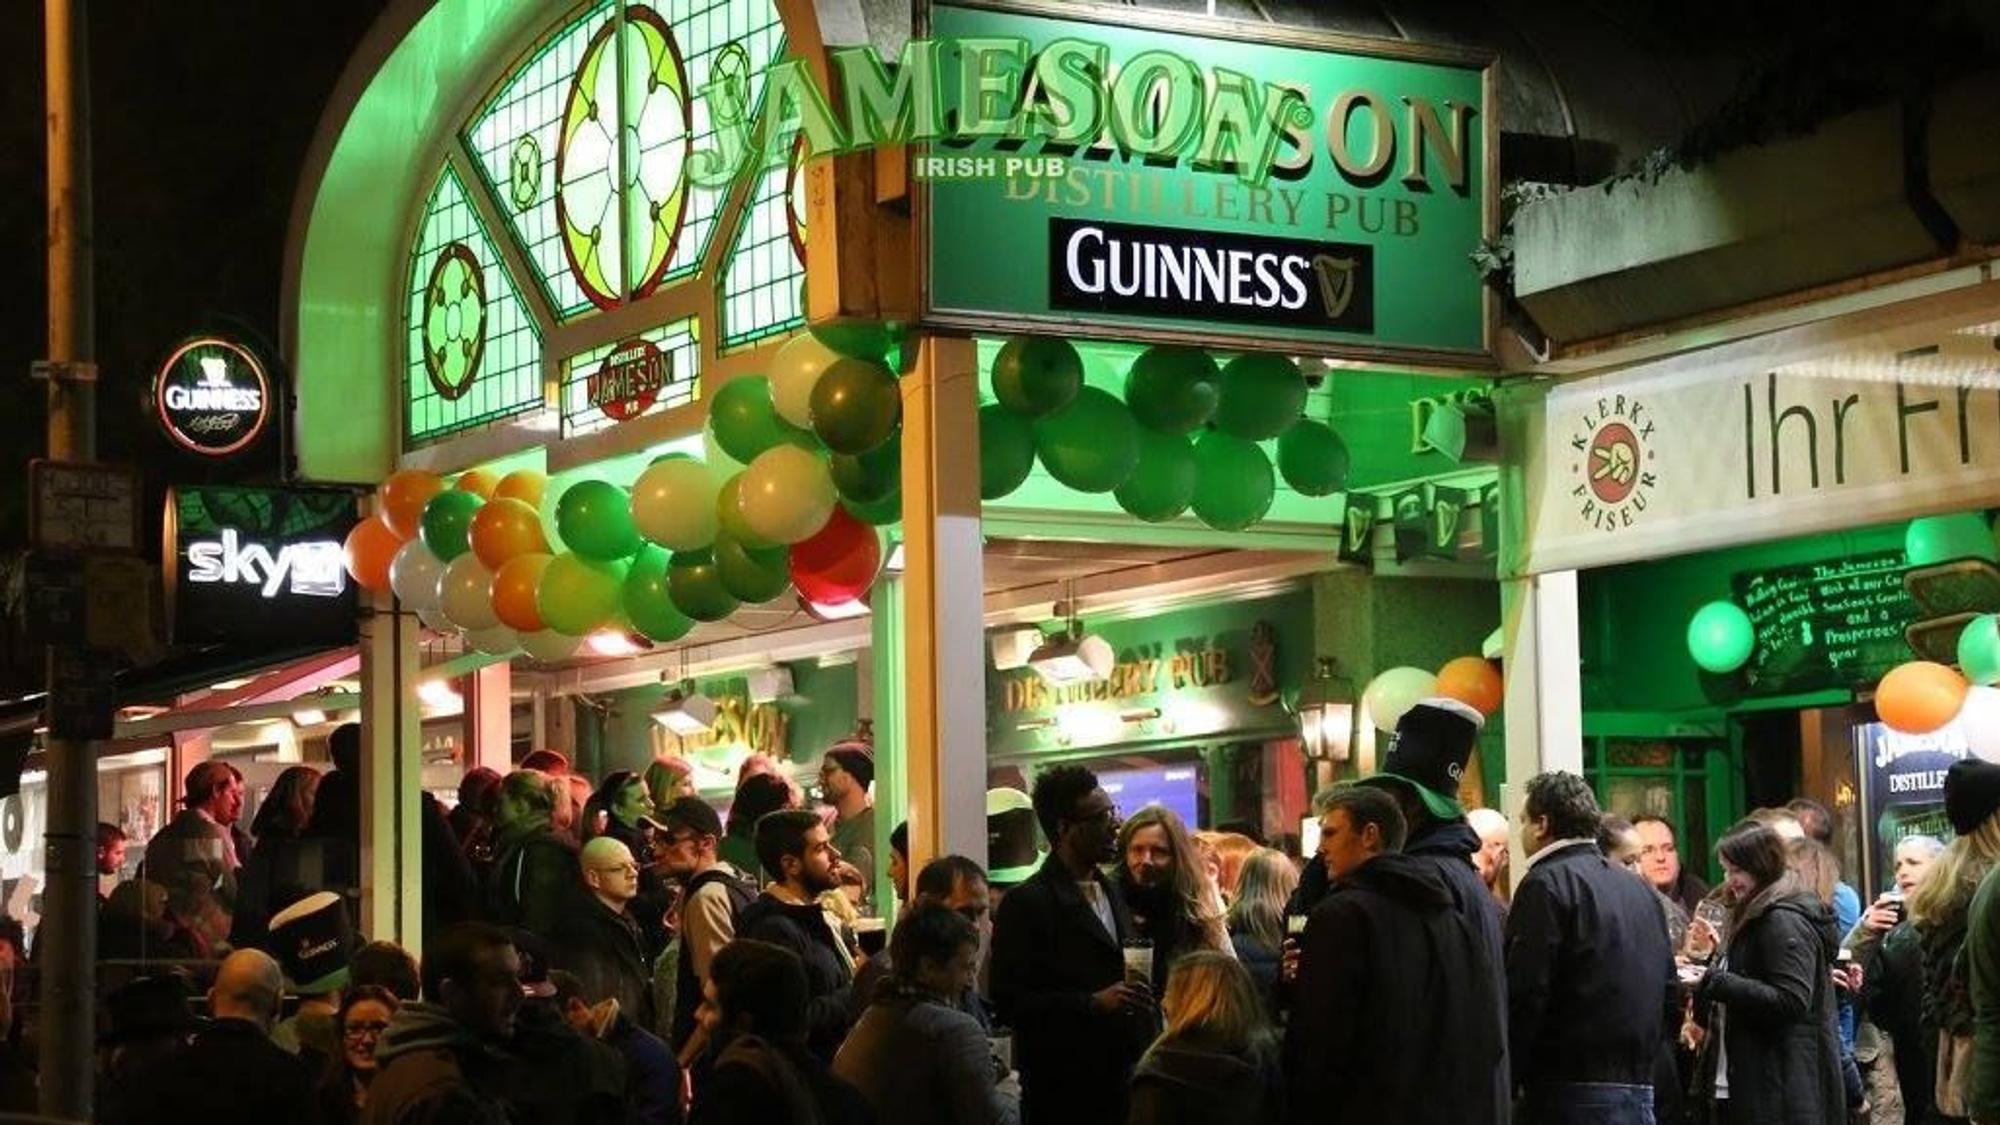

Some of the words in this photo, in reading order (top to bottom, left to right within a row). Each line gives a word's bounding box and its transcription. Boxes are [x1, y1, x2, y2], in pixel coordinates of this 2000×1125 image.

[1327, 193, 1420, 237] PUB
[1066, 227, 1309, 310] GUINNESS
[165, 385, 261, 410] GUINNESS
[1572, 394, 1655, 452] KLERKX
[1744, 373, 1859, 499] Ihr
[1573, 471, 1656, 532] FRISEUR
[188, 528, 293, 597] sky
